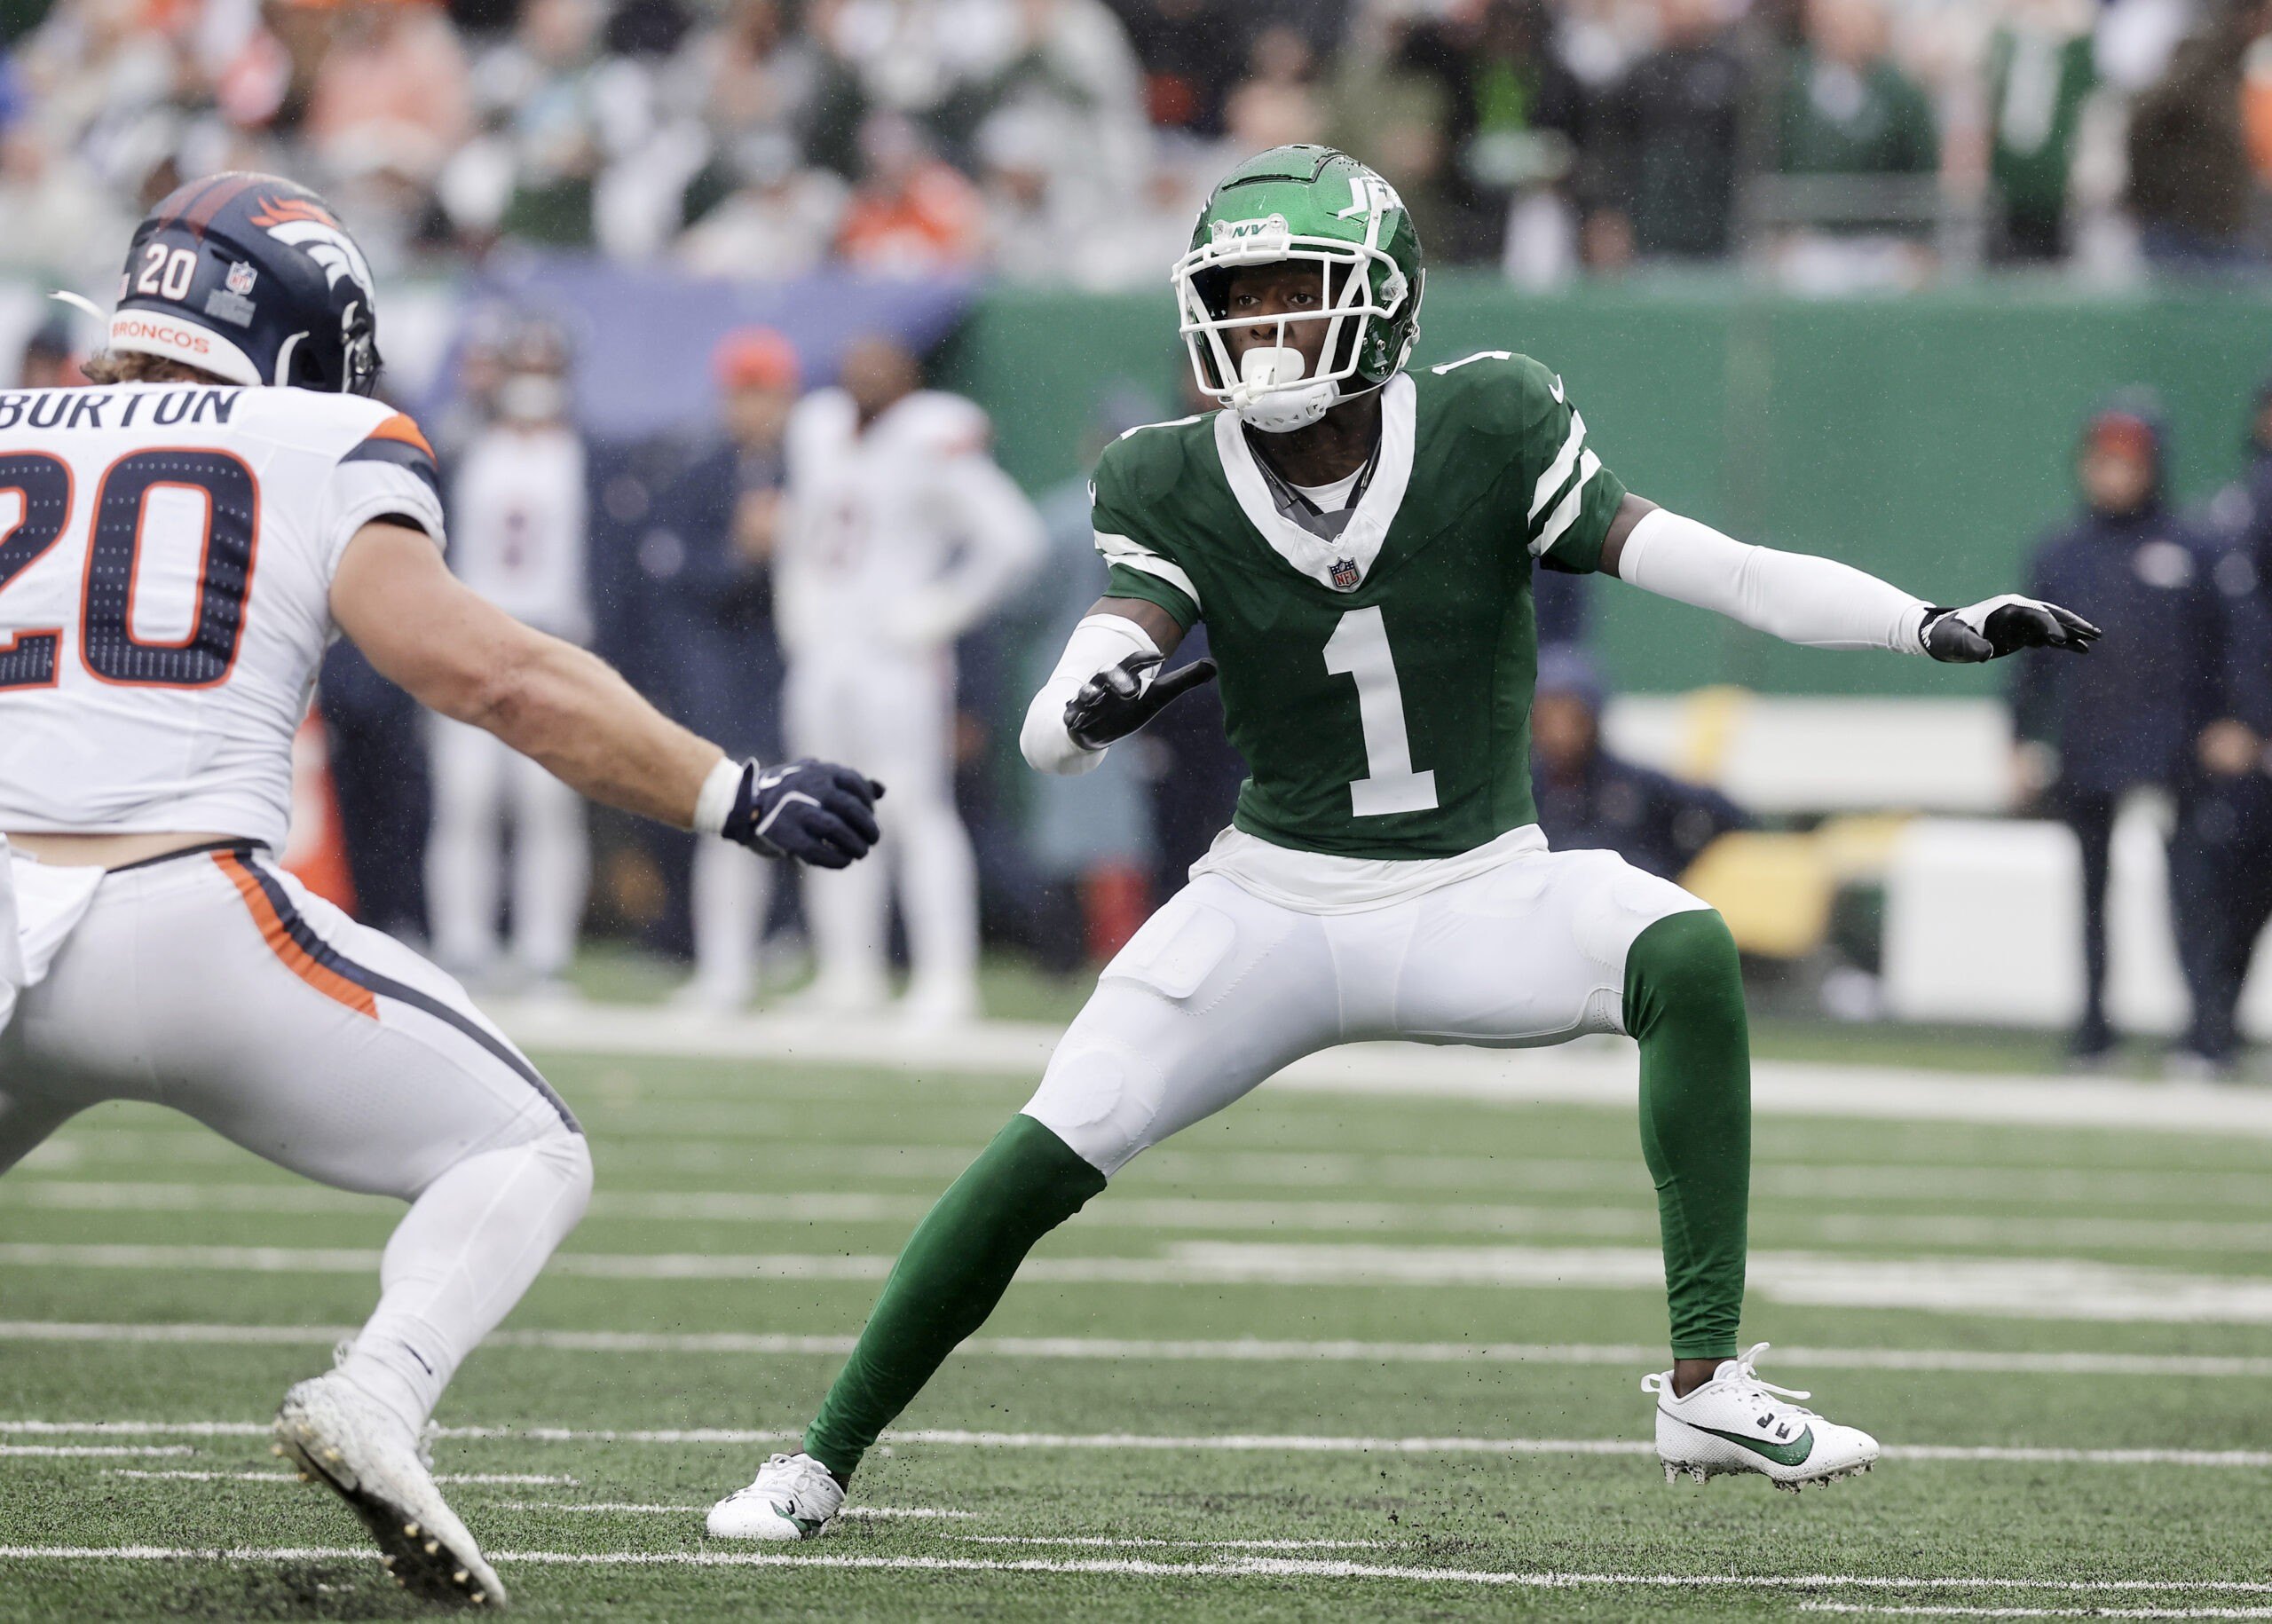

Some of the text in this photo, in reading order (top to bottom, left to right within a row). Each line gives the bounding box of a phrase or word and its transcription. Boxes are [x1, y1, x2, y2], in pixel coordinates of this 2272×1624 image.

[137, 243, 197, 301] 20
[112, 321, 210, 354] BRONCOS
[0, 390, 242, 430] BURTON
[1336, 571, 1357, 586] NFL
[1322, 605, 1439, 817] 1
